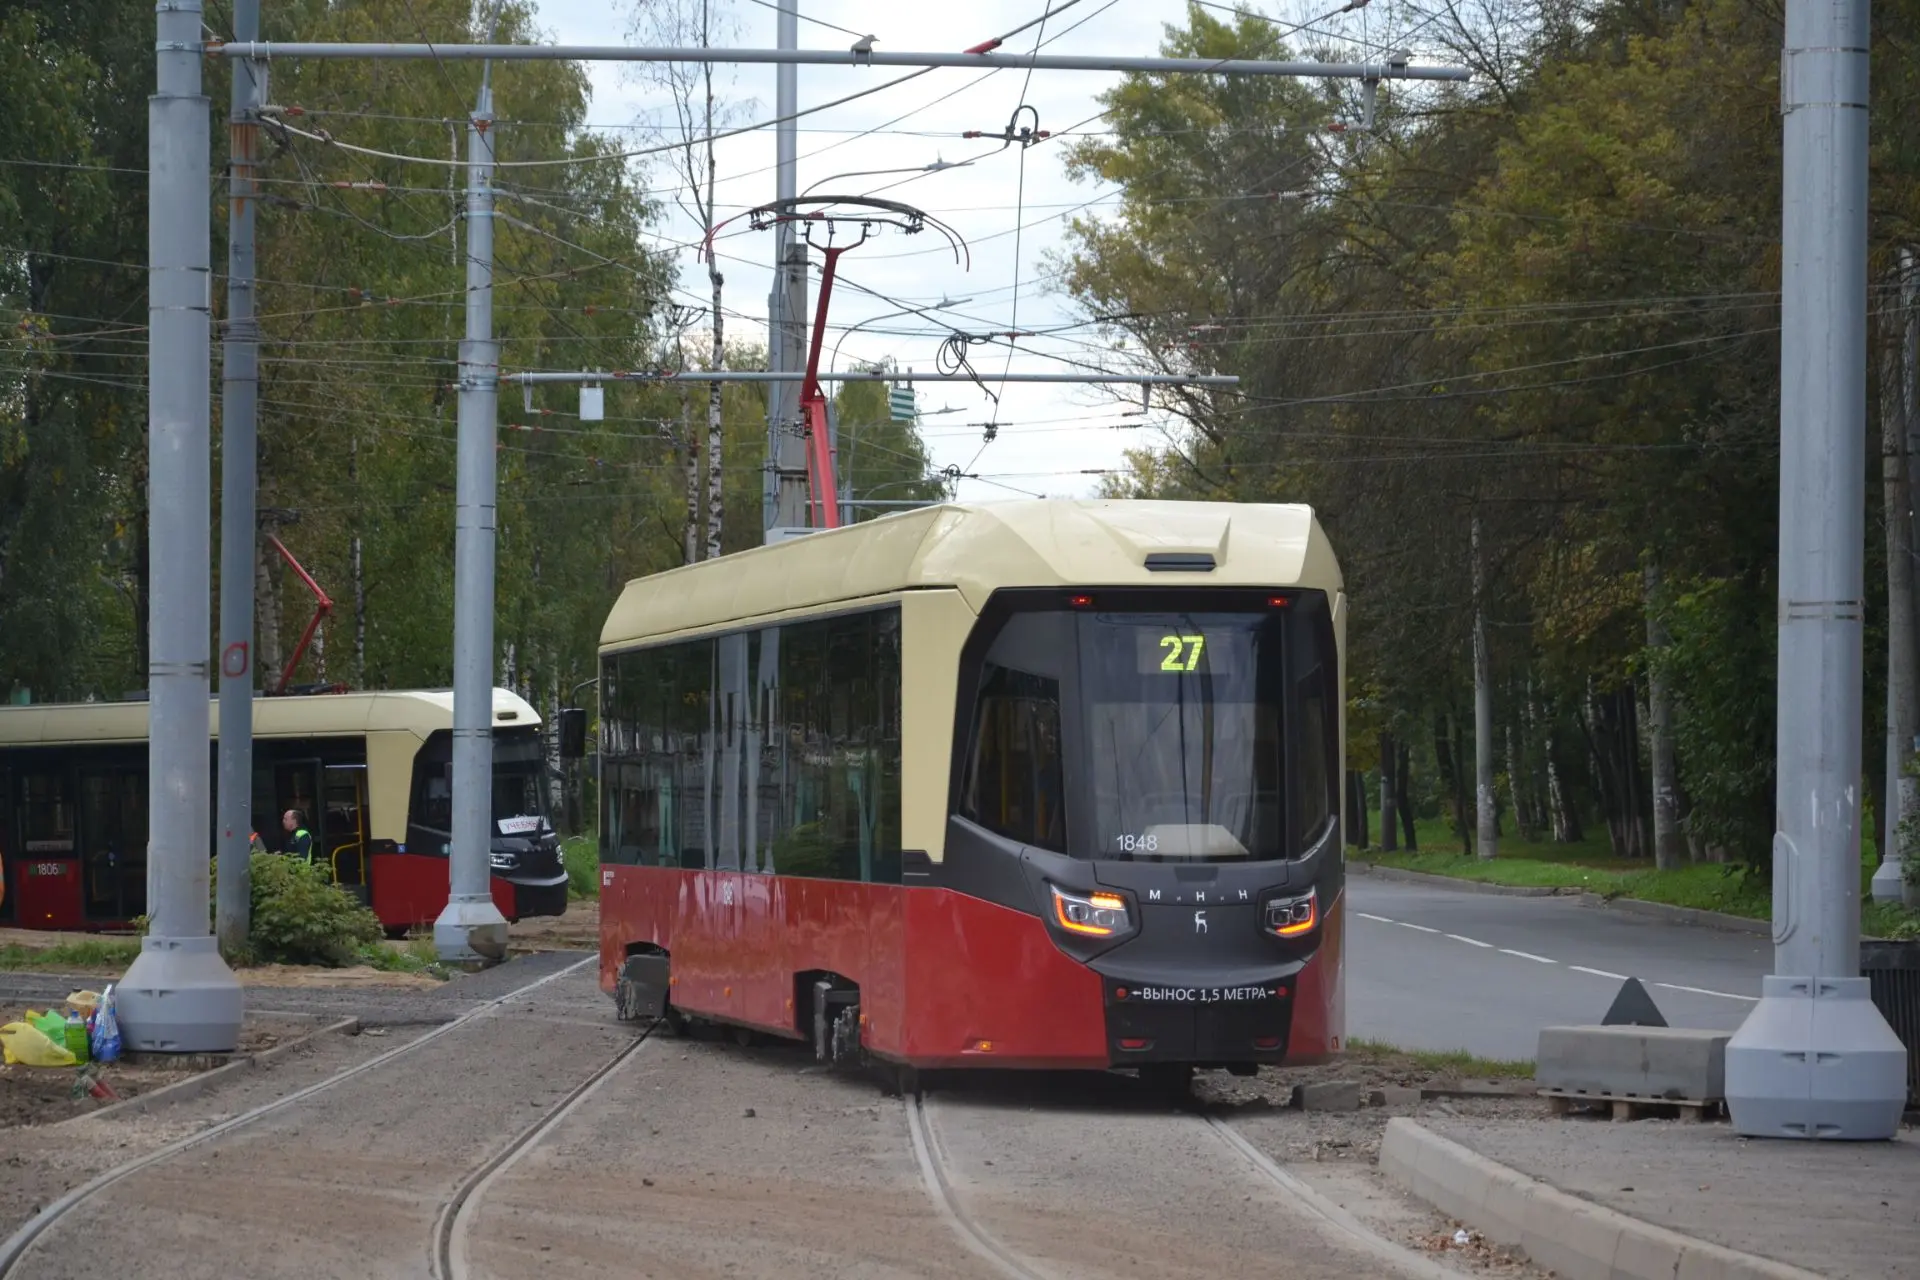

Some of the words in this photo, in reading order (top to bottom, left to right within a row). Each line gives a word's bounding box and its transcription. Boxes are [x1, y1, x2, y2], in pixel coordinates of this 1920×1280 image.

[1160, 635, 1204, 671] 27
[1116, 834, 1158, 851] 1848
[37, 863, 59, 876] 1806
[1143, 987, 1196, 1001] ВЫНОС
[1200, 988, 1220, 1003] 1,5
[1224, 987, 1266, 1001] МЕТРА
